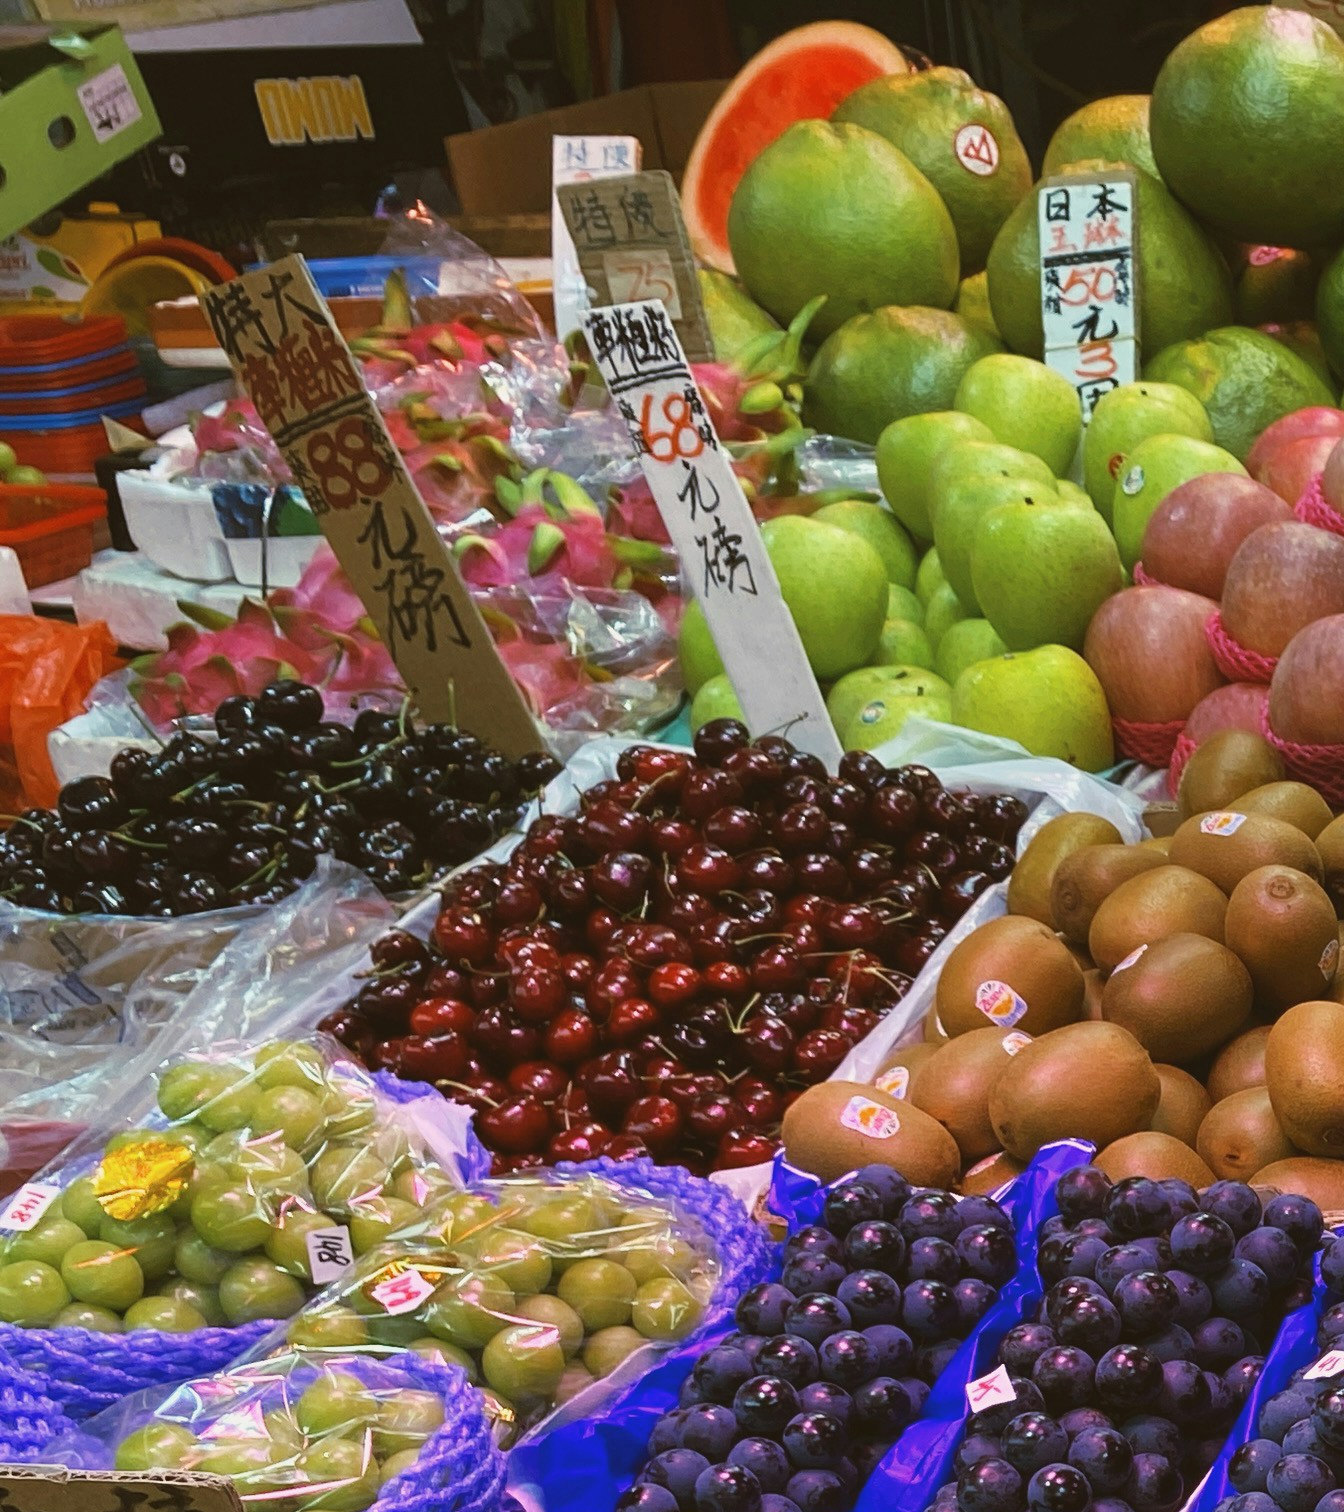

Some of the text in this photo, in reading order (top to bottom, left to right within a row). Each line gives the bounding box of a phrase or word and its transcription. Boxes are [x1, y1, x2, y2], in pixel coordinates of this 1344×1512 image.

[1045, 182, 1129, 222] 日本
[1059, 267, 1117, 308] 50
[1072, 303, 1119, 344] 元
[1074, 341, 1118, 379] 3
[639, 392, 706, 464] 68
[307, 414, 394, 510] 88
[676, 459, 721, 522] 元
[694, 515, 759, 599] 磅
